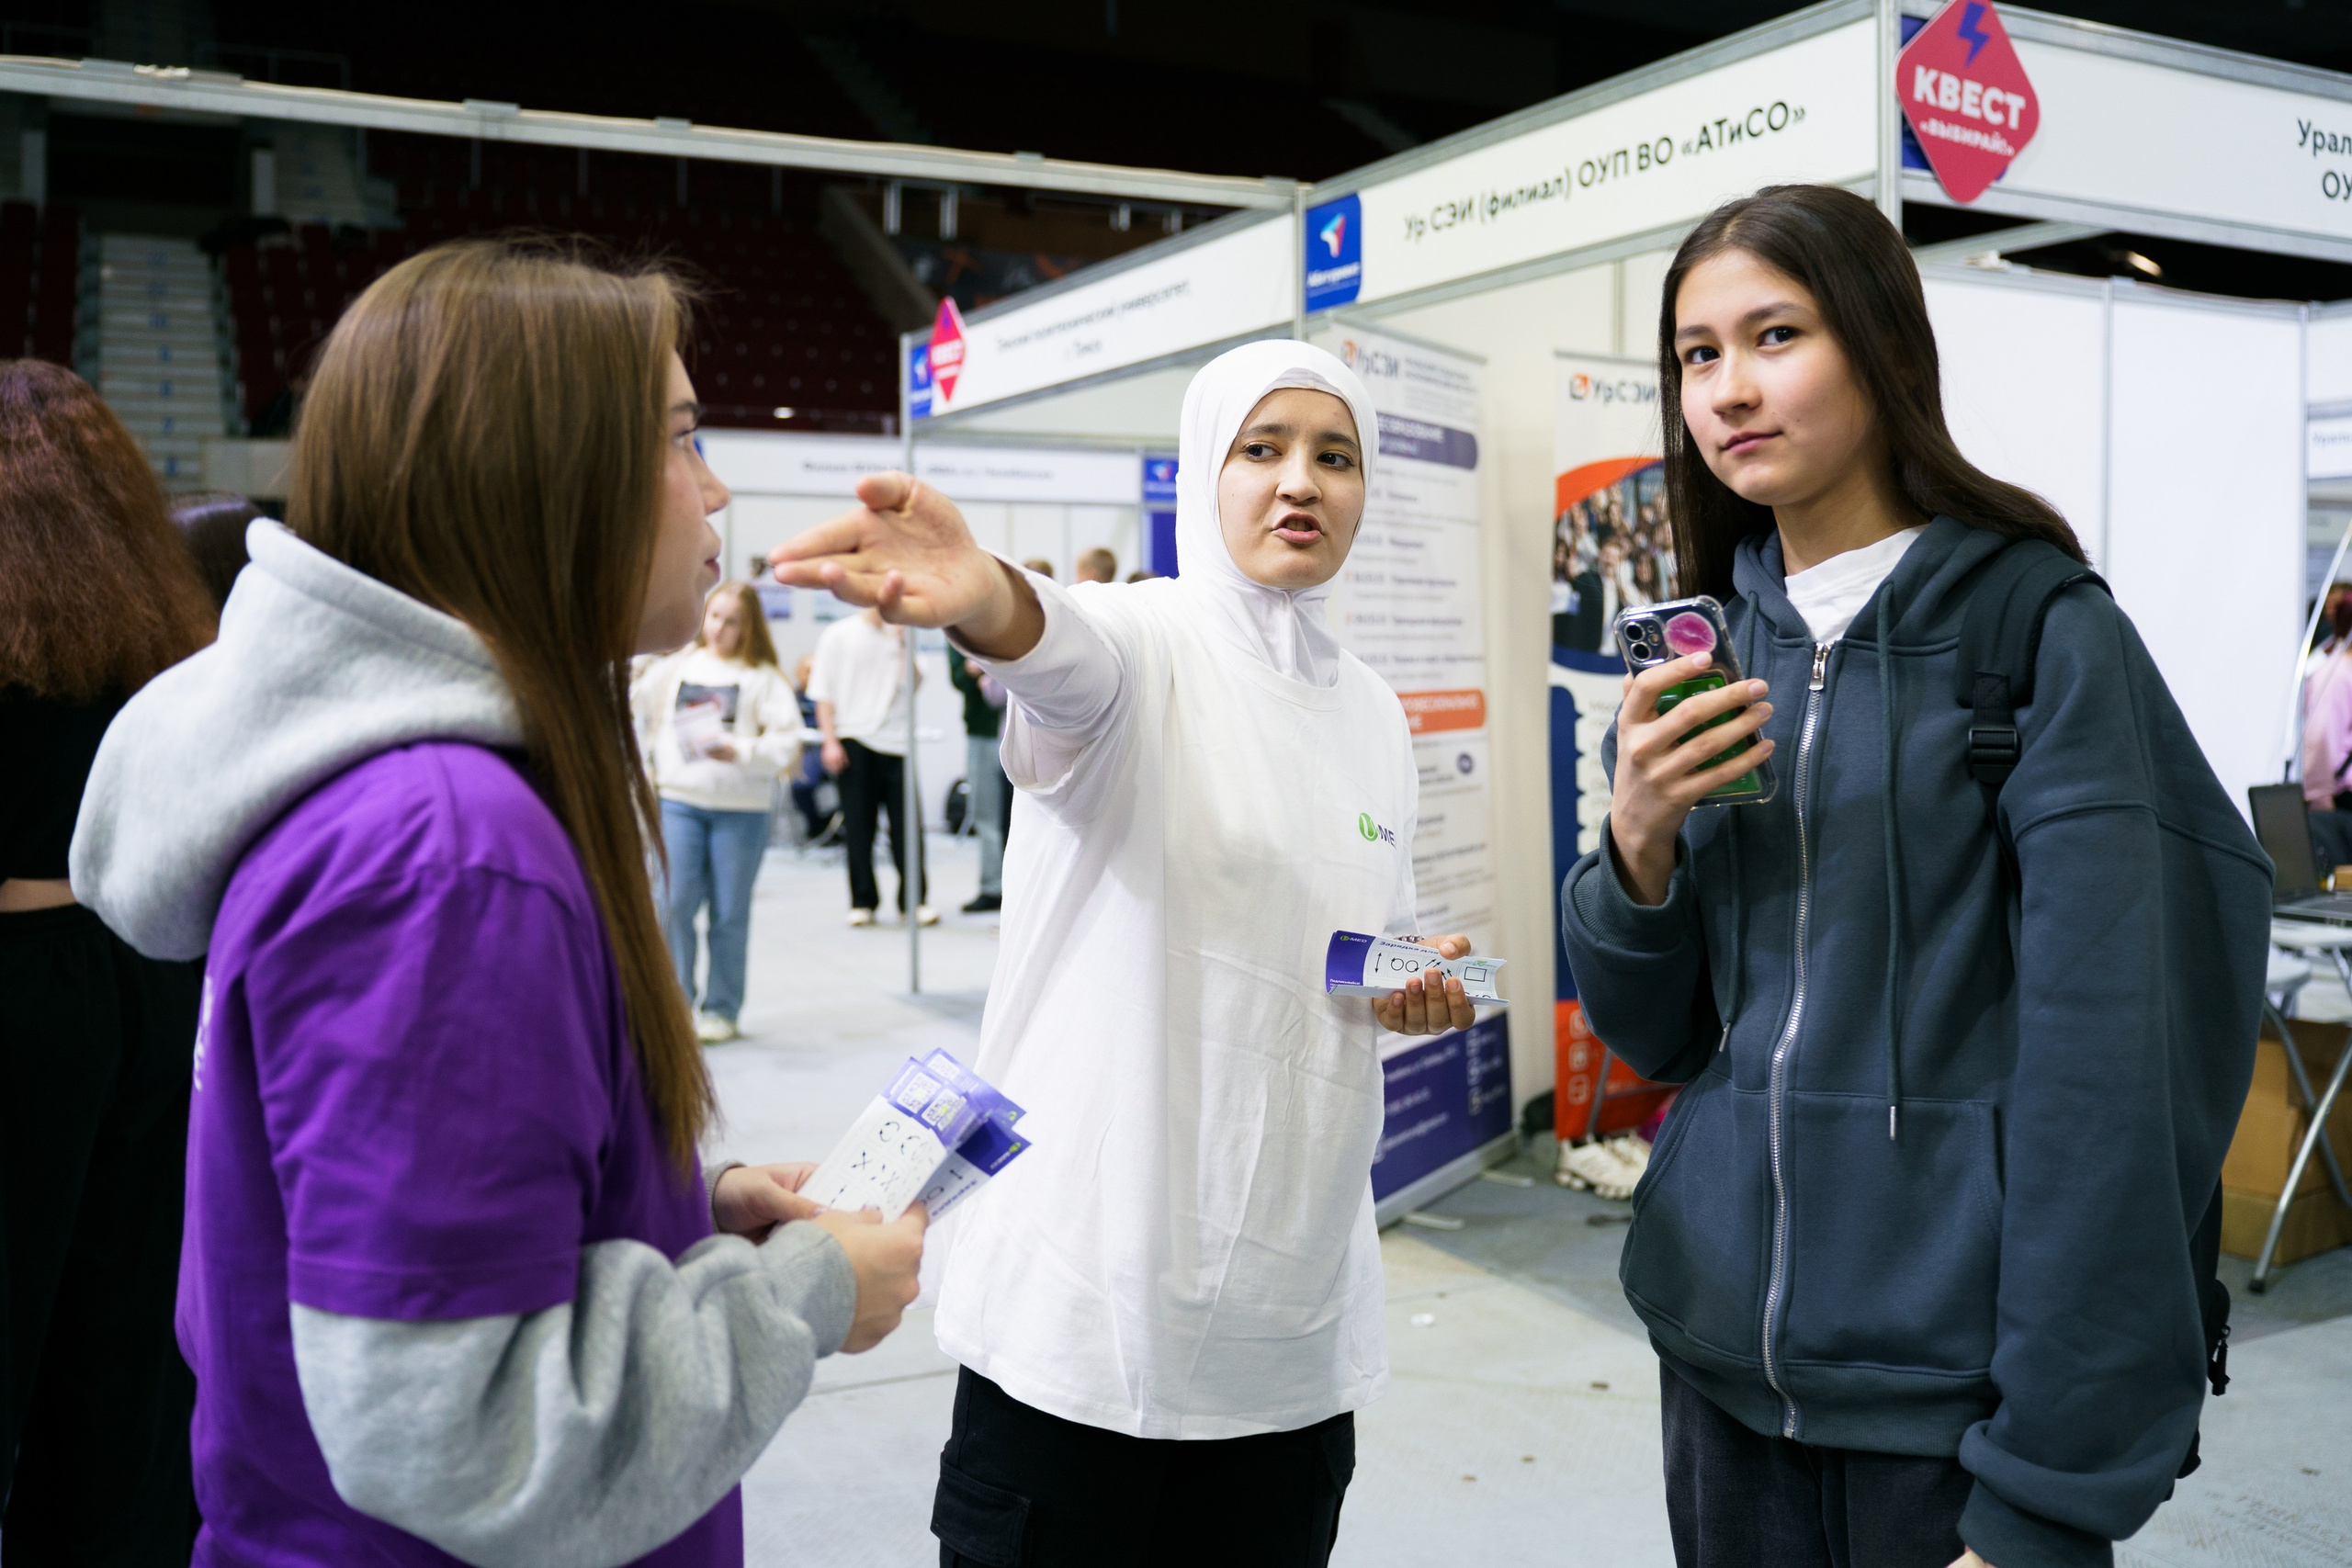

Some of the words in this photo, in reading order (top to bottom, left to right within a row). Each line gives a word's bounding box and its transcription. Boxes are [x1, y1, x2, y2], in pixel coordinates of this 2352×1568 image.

[1913, 64, 2027, 131] КВЕСТ
[1405, 214, 1428, 243] Ур
[1430, 198, 1475, 231] СЭИ
[1478, 167, 1572, 225] (филиал)
[1577, 149, 1630, 189] ОУП
[1637, 136, 1674, 173] ВО
[1680, 100, 1806, 156] «АТиСО»
[1379, 942, 1419, 951] Зарядка
